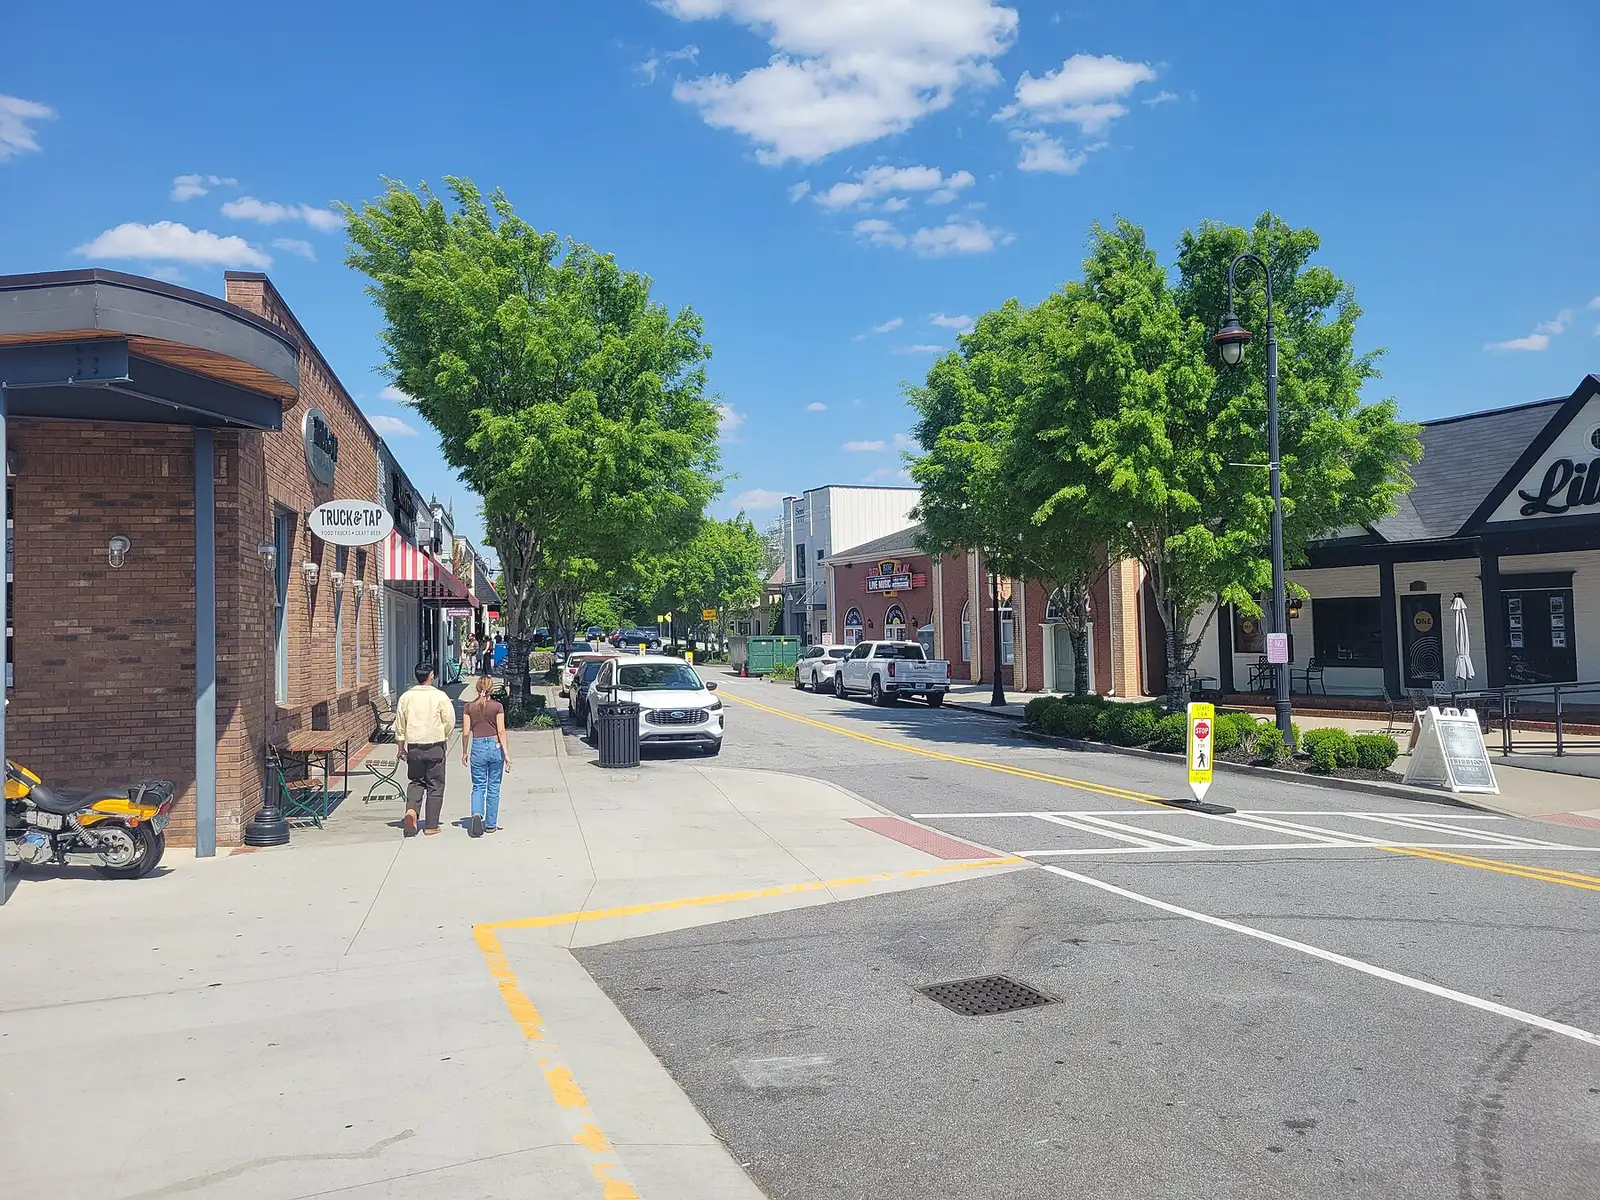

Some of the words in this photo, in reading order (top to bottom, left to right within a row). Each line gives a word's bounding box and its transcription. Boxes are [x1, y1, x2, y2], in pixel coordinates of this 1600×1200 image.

[868, 567, 879, 576] RED
[896, 563, 910, 574] CLAY
[869, 580, 878, 590] LIVE
[878, 579, 891, 589] MUSIC
